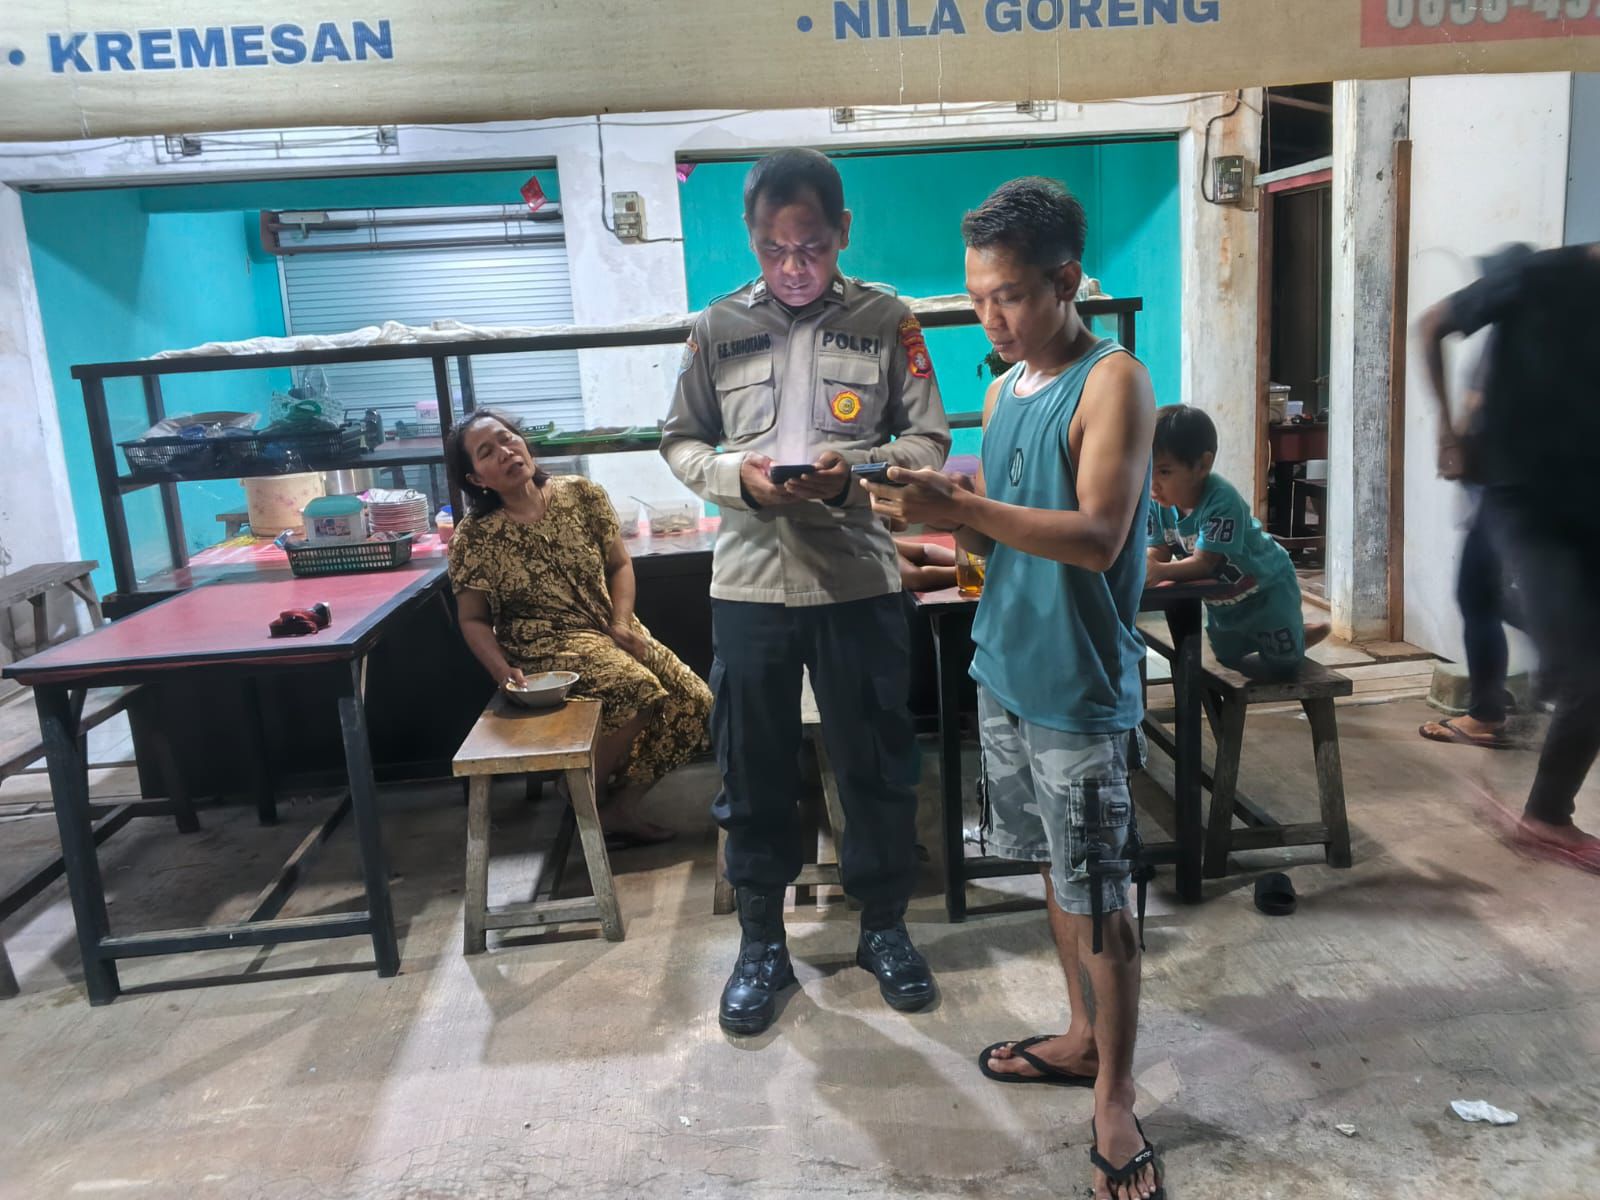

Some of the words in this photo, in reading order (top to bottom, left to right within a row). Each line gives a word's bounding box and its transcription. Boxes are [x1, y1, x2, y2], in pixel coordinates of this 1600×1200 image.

[834, 0, 966, 40] NILA
[984, 0, 1220, 33] GORENG
[48, 19, 394, 73] KREMESAN
[822, 331, 879, 354] POLRI
[1205, 515, 1235, 544] 78
